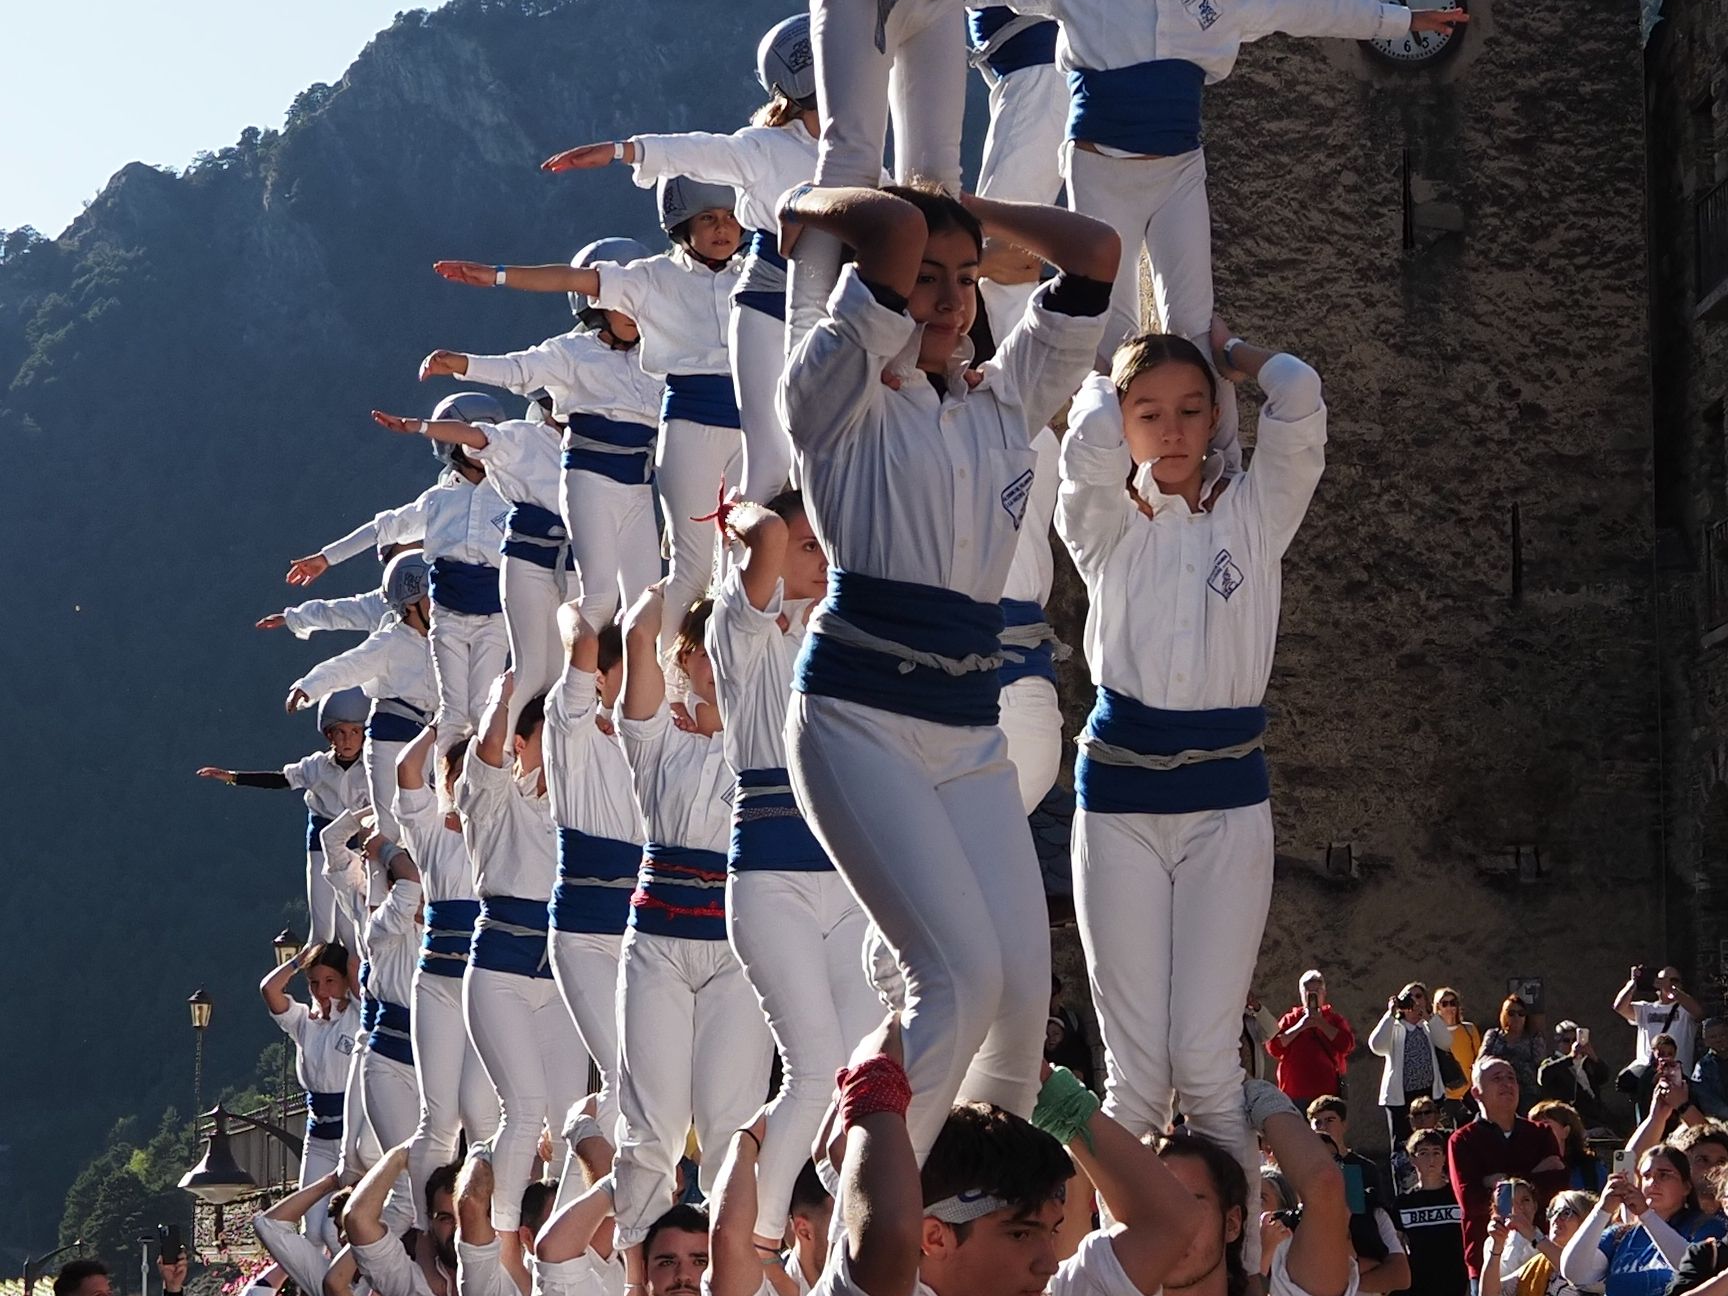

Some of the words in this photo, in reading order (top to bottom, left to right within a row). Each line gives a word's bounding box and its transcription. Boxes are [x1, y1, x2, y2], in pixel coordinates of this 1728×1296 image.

[1404, 40, 1411, 53] 6
[1422, 37, 1429, 48] 5
[1410, 1207, 1453, 1223] BREAK
